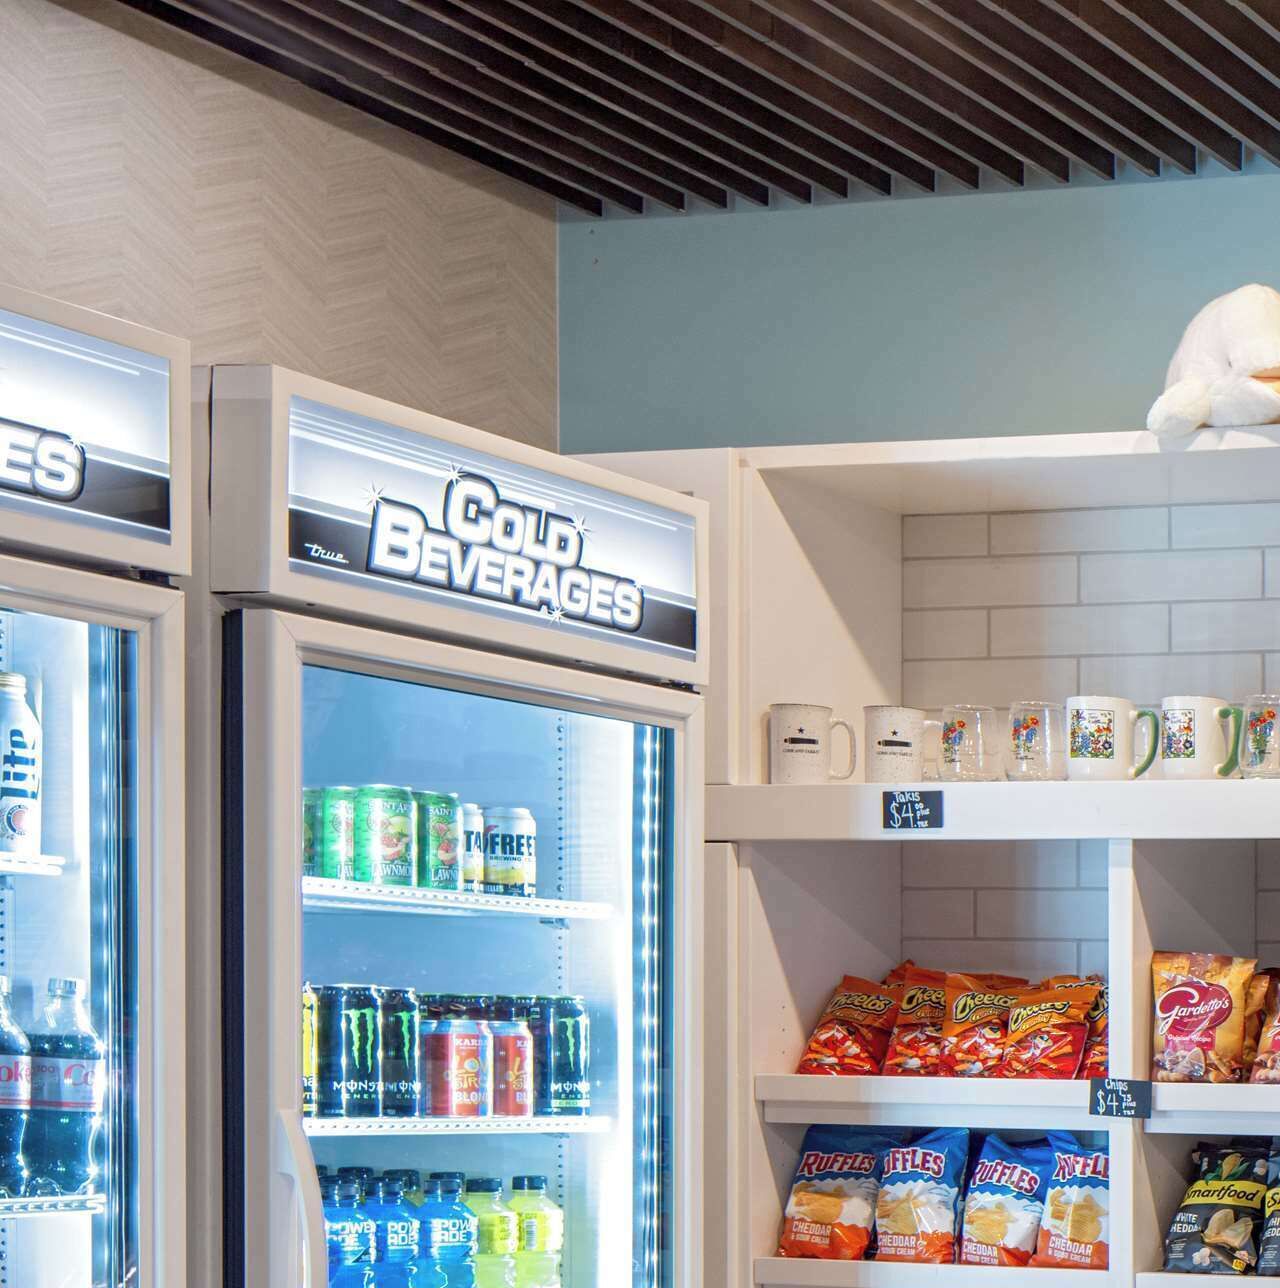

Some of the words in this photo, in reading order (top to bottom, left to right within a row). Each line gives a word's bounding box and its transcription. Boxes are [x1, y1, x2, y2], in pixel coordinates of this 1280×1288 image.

[445, 474, 583, 570] COLD
[304, 543, 349, 564] true
[367, 500, 644, 631] BEVERAGES
[893, 791, 921, 803] Takis
[1158, 986, 1230, 1036] Gardetto's
[1104, 1079, 1129, 1096] Chips
[800, 1151, 877, 1176] RUFFLES
[792, 1220, 831, 1237] CHEDDAR
[878, 1234, 917, 1249] CHEDDAR
[962, 1243, 999, 1258] CHEDDAR
[1048, 1238, 1094, 1256] CHEDDAR
